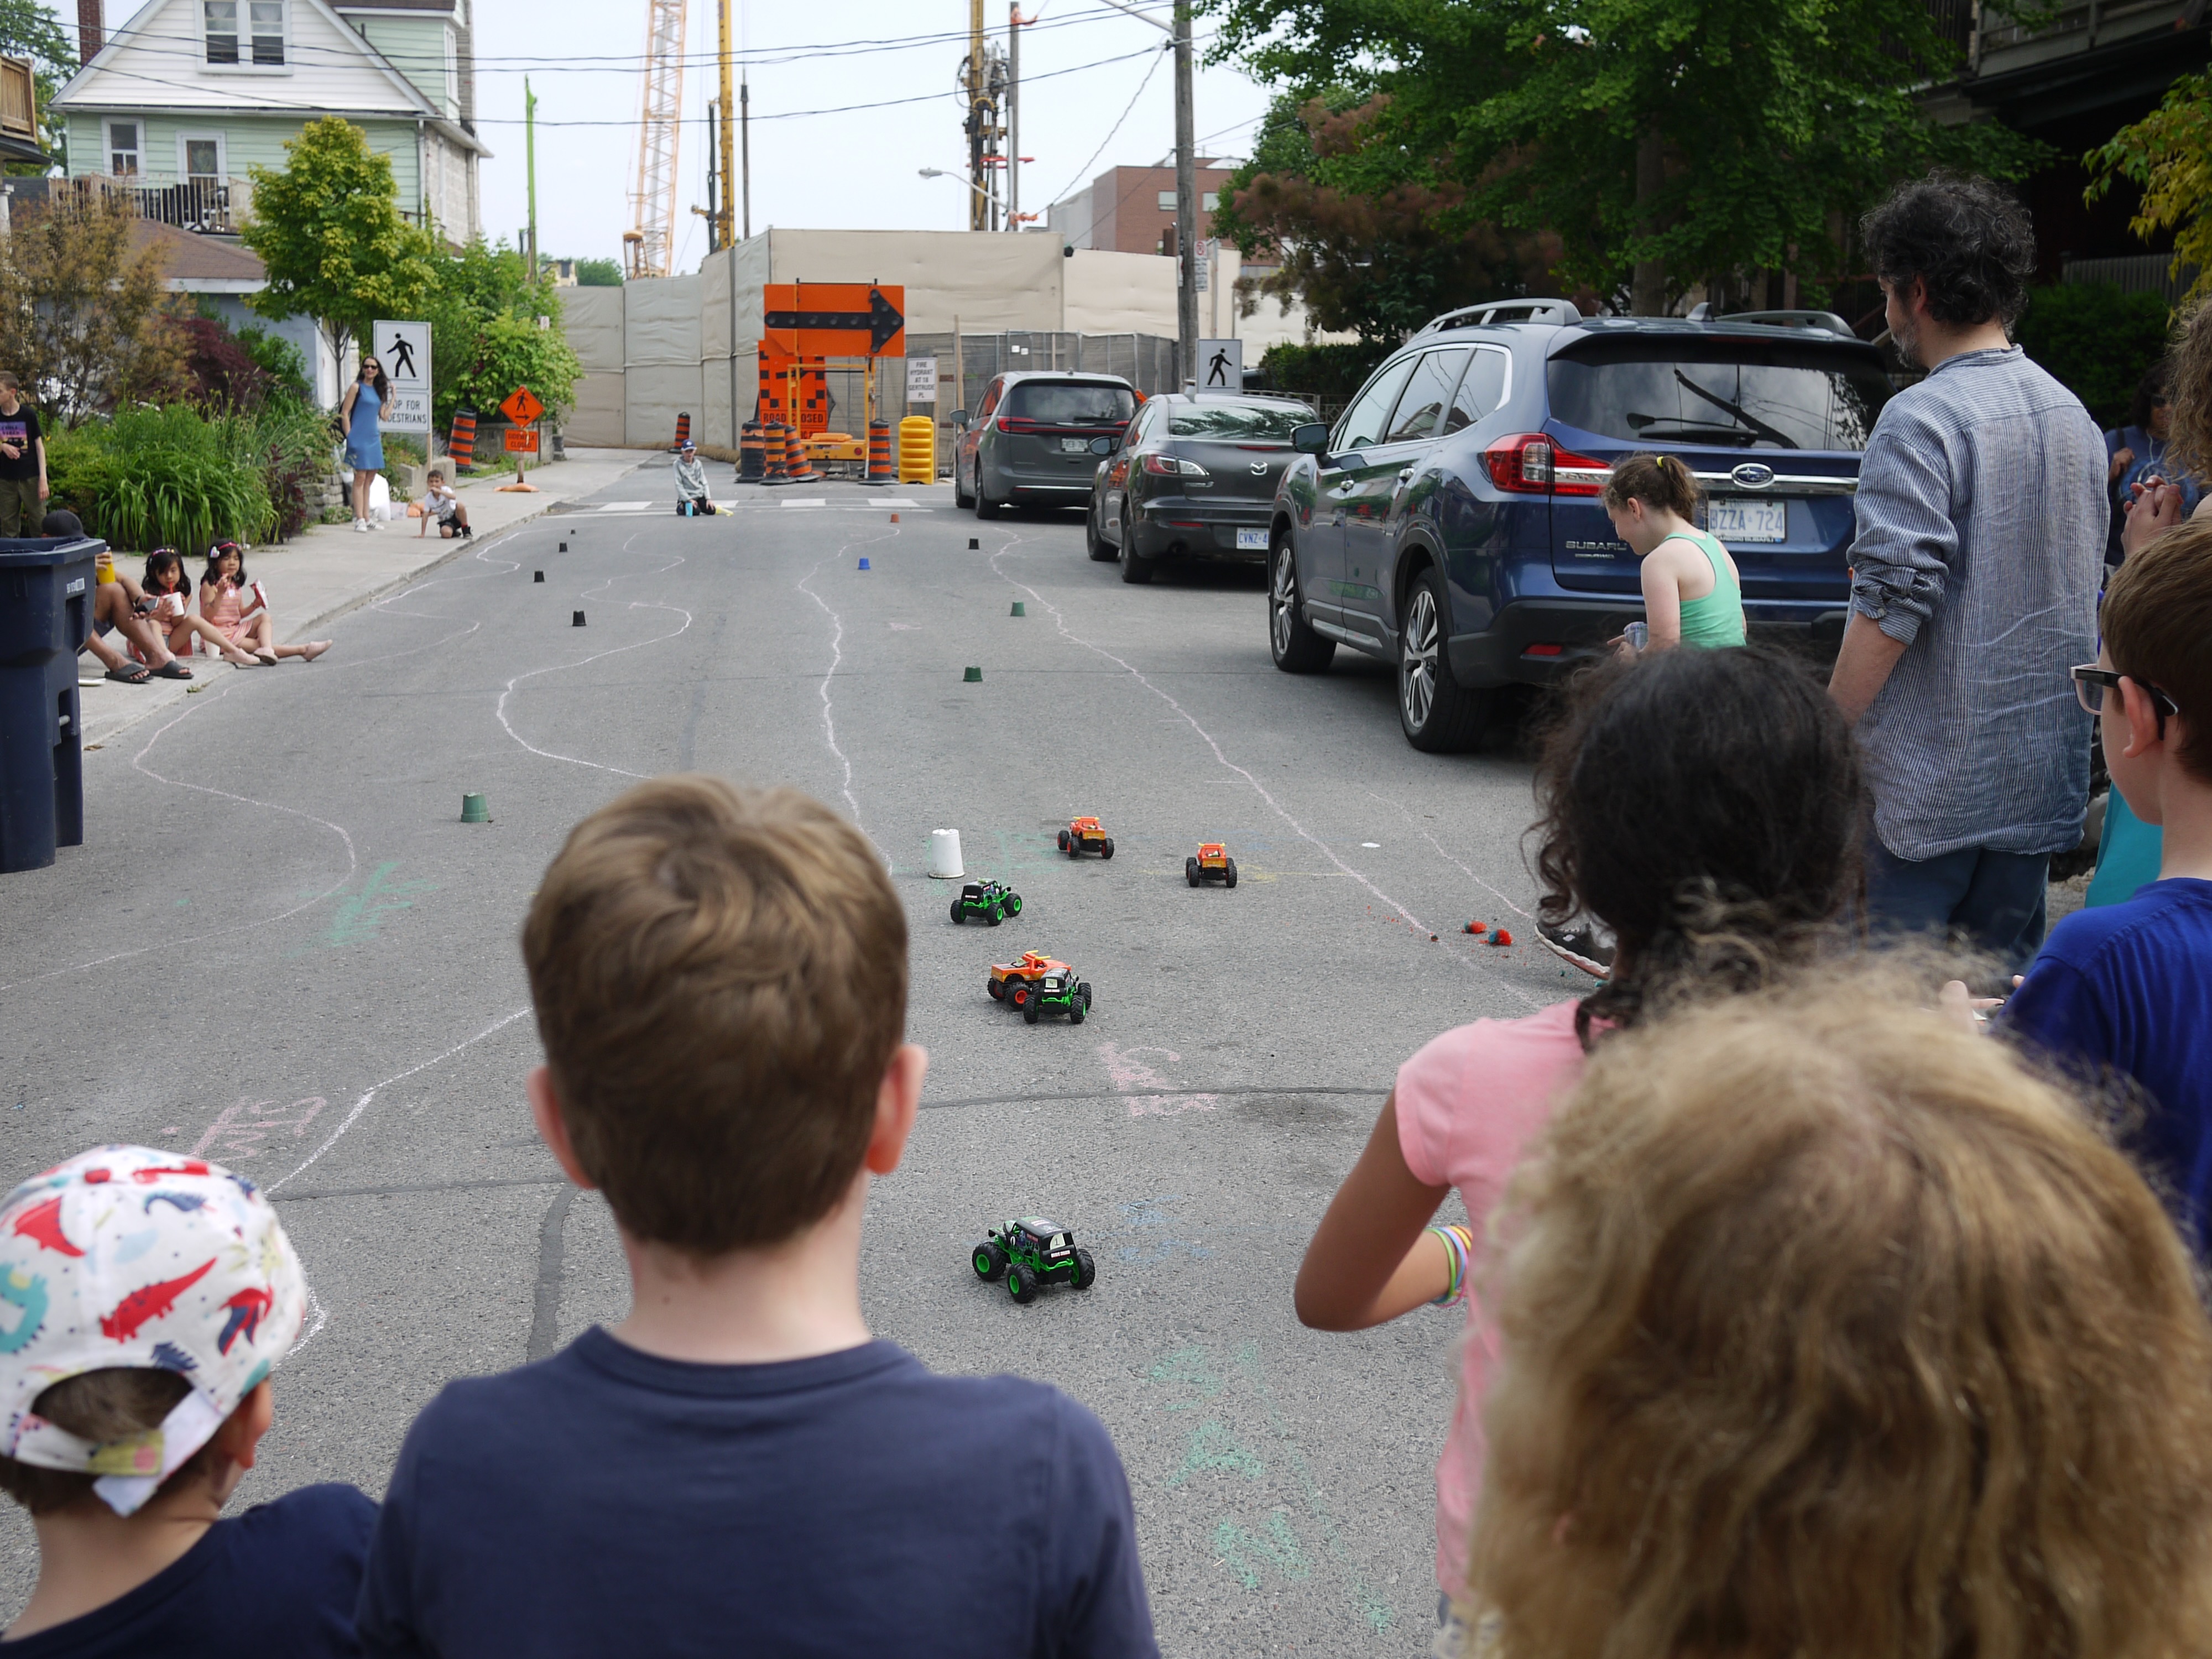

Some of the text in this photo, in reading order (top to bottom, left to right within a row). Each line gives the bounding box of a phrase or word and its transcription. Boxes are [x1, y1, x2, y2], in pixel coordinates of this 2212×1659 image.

[406, 400, 420, 410] FOR
[379, 413, 427, 424] DESTRIANS
[763, 413, 823, 422] ROAD COSED
[1566, 541, 1627, 551] SUBARU
